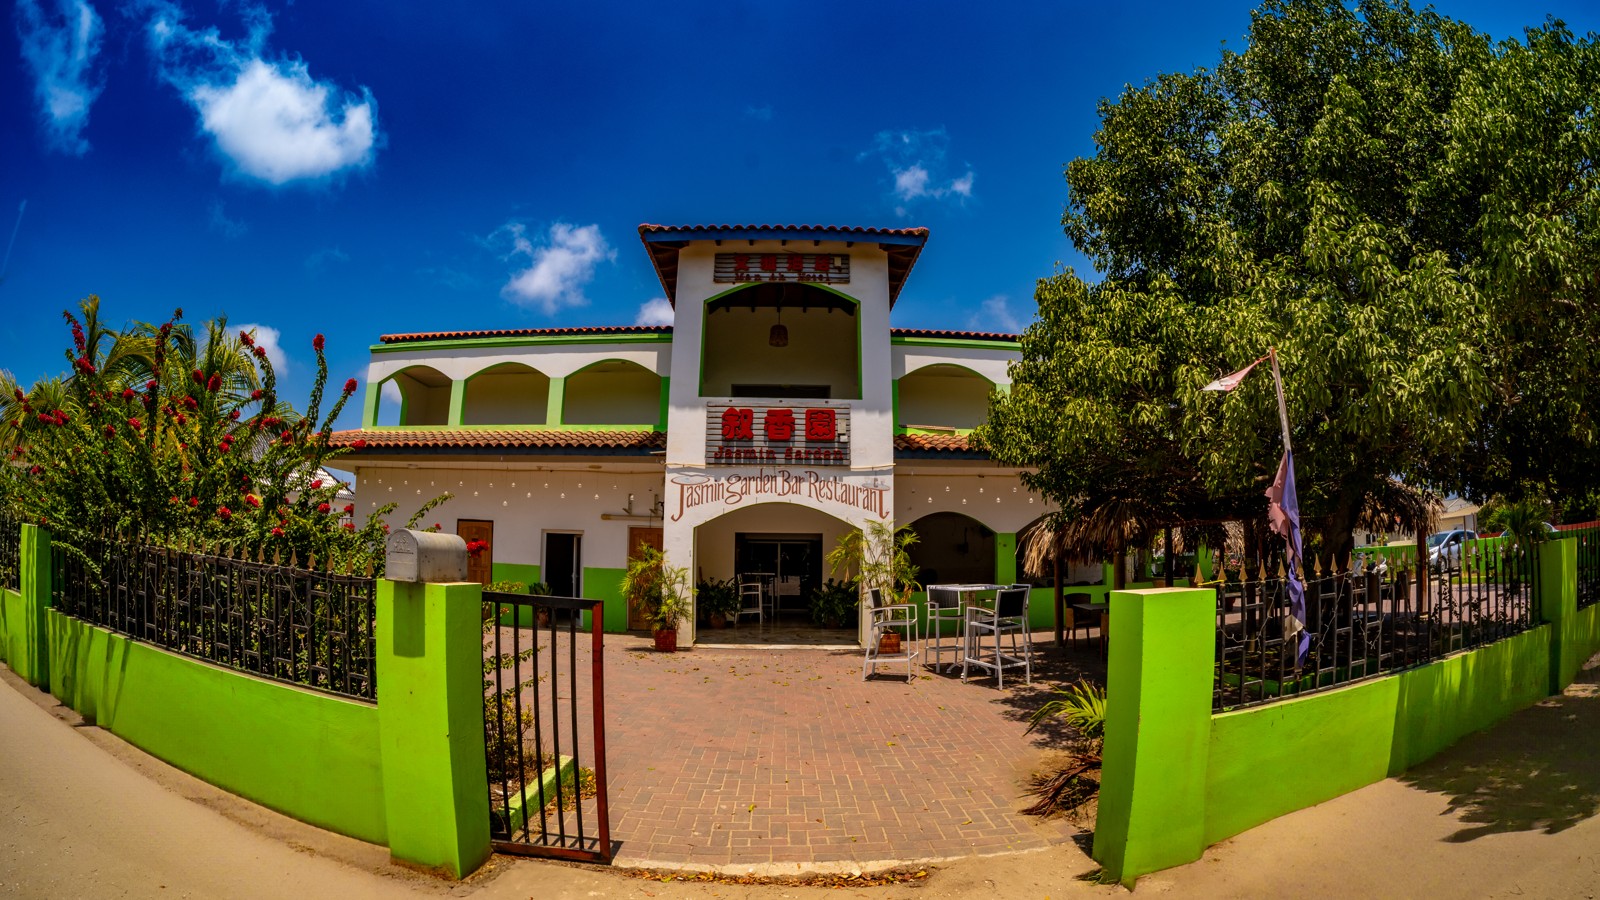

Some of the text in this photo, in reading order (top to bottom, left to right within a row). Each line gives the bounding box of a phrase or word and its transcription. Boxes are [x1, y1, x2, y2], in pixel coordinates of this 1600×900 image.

[714, 446, 776, 460] Jasmin
[671, 476, 724, 522] Jasmin
[778, 470, 804, 496] Bar
[805, 470, 890, 520] Restaurant
